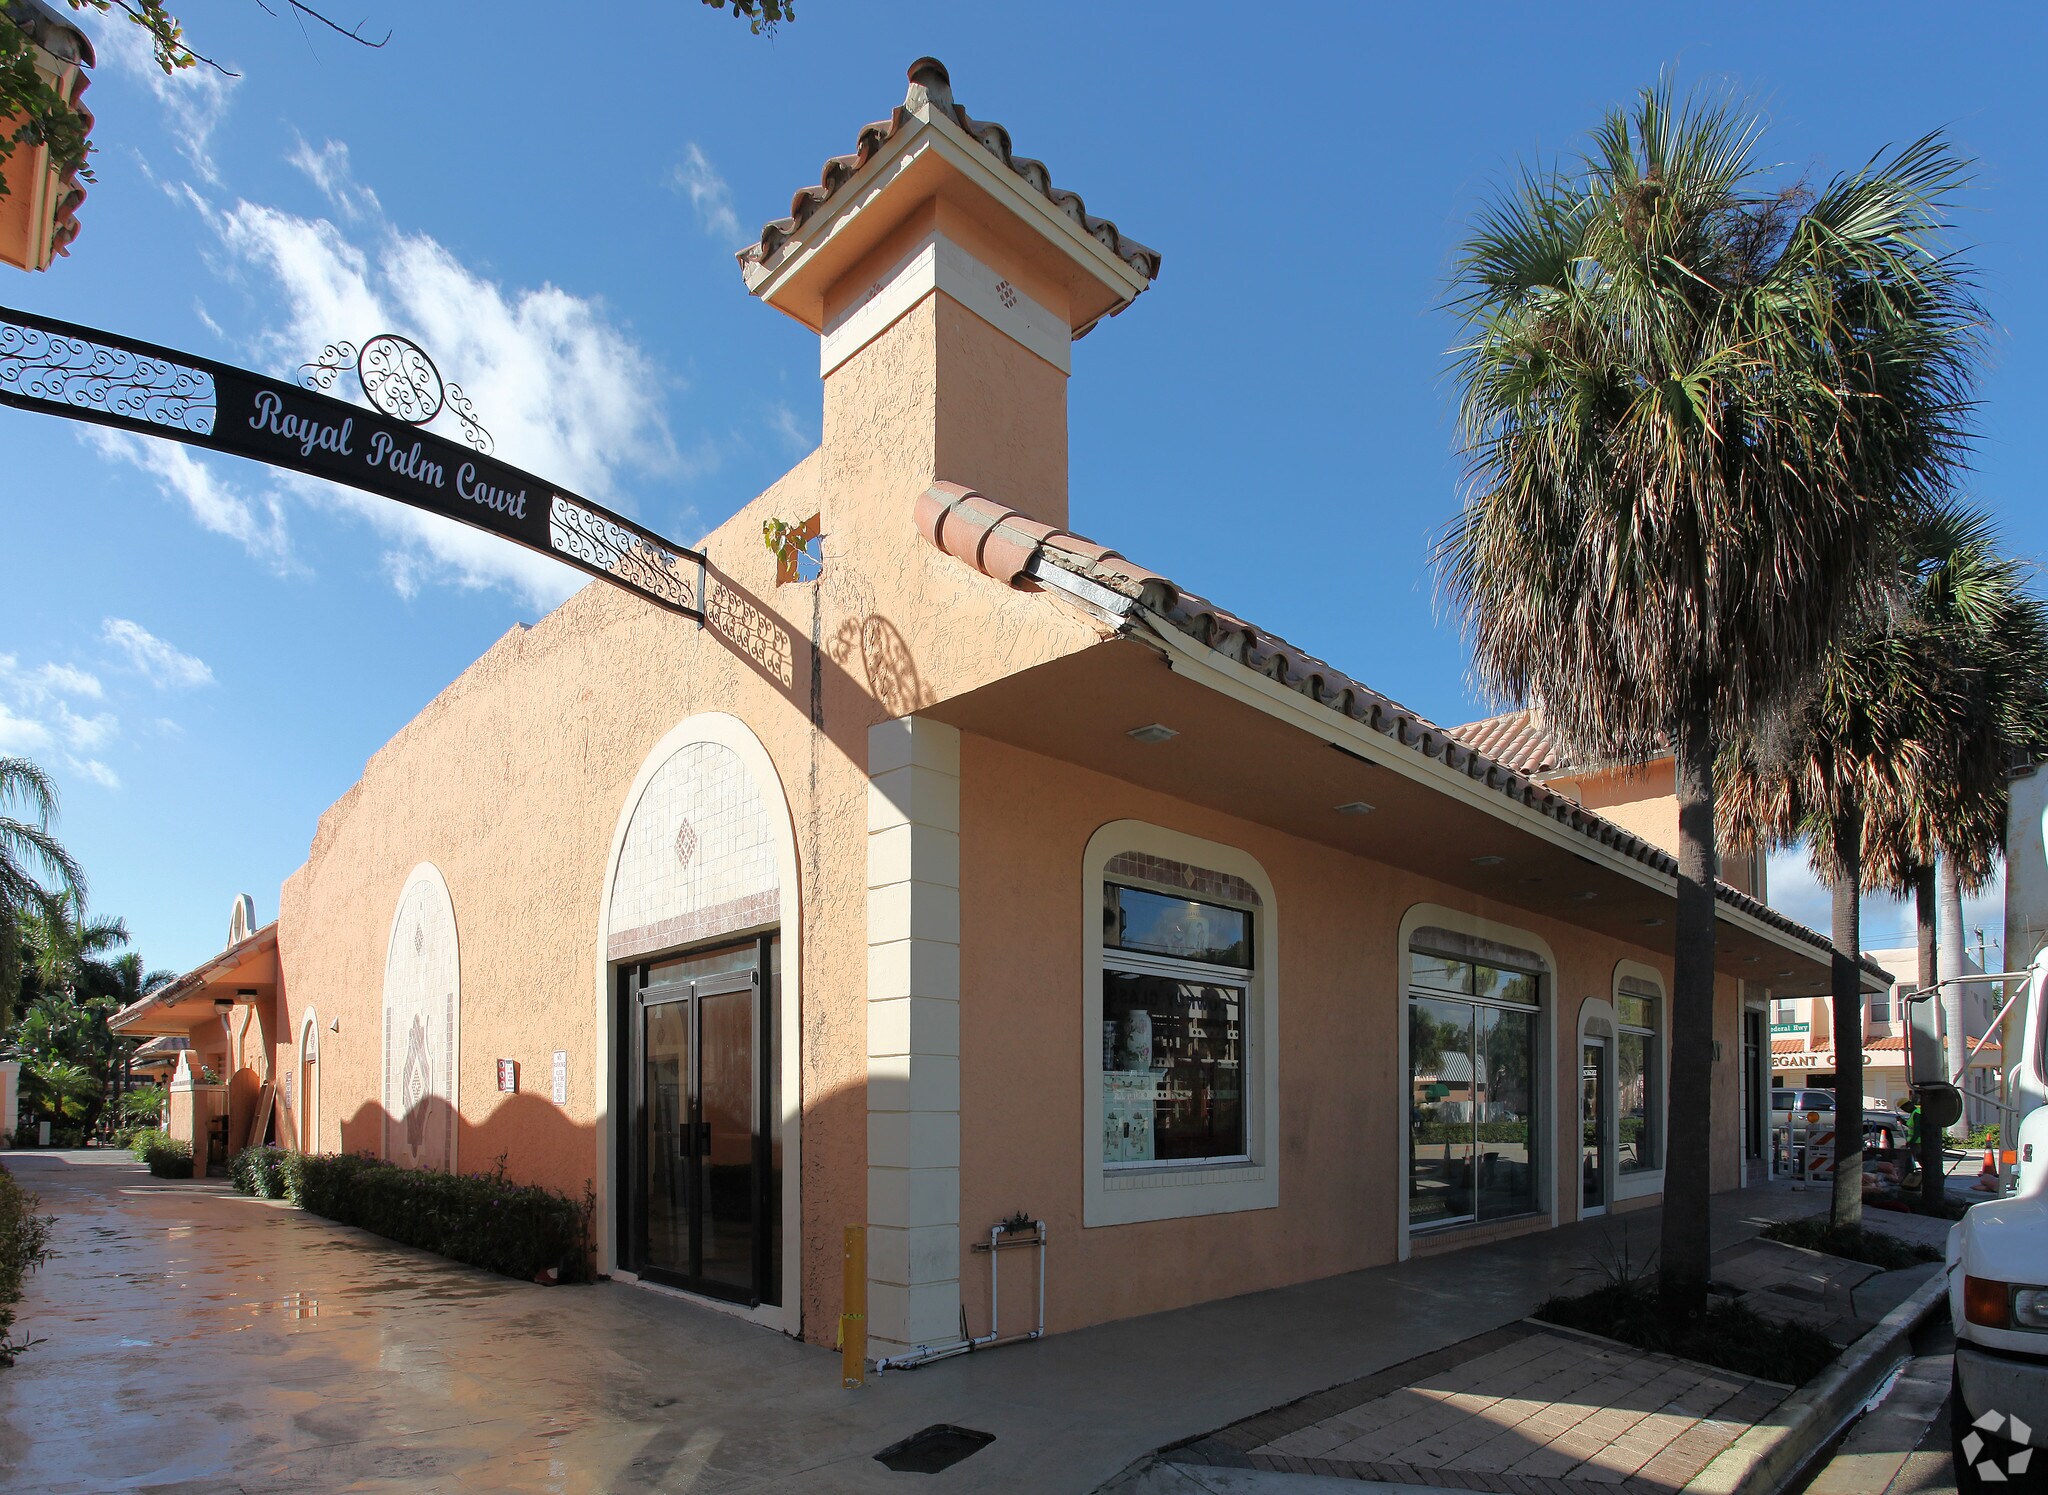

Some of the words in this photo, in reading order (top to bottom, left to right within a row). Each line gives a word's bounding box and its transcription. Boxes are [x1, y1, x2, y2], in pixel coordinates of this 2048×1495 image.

[249, 390, 353, 456] Royal
[366, 431, 445, 489] Palm
[456, 462, 527, 520] Court
[1793, 1024, 1808, 1032] Hwy
[1772, 1055, 1818, 1067] EGANT
